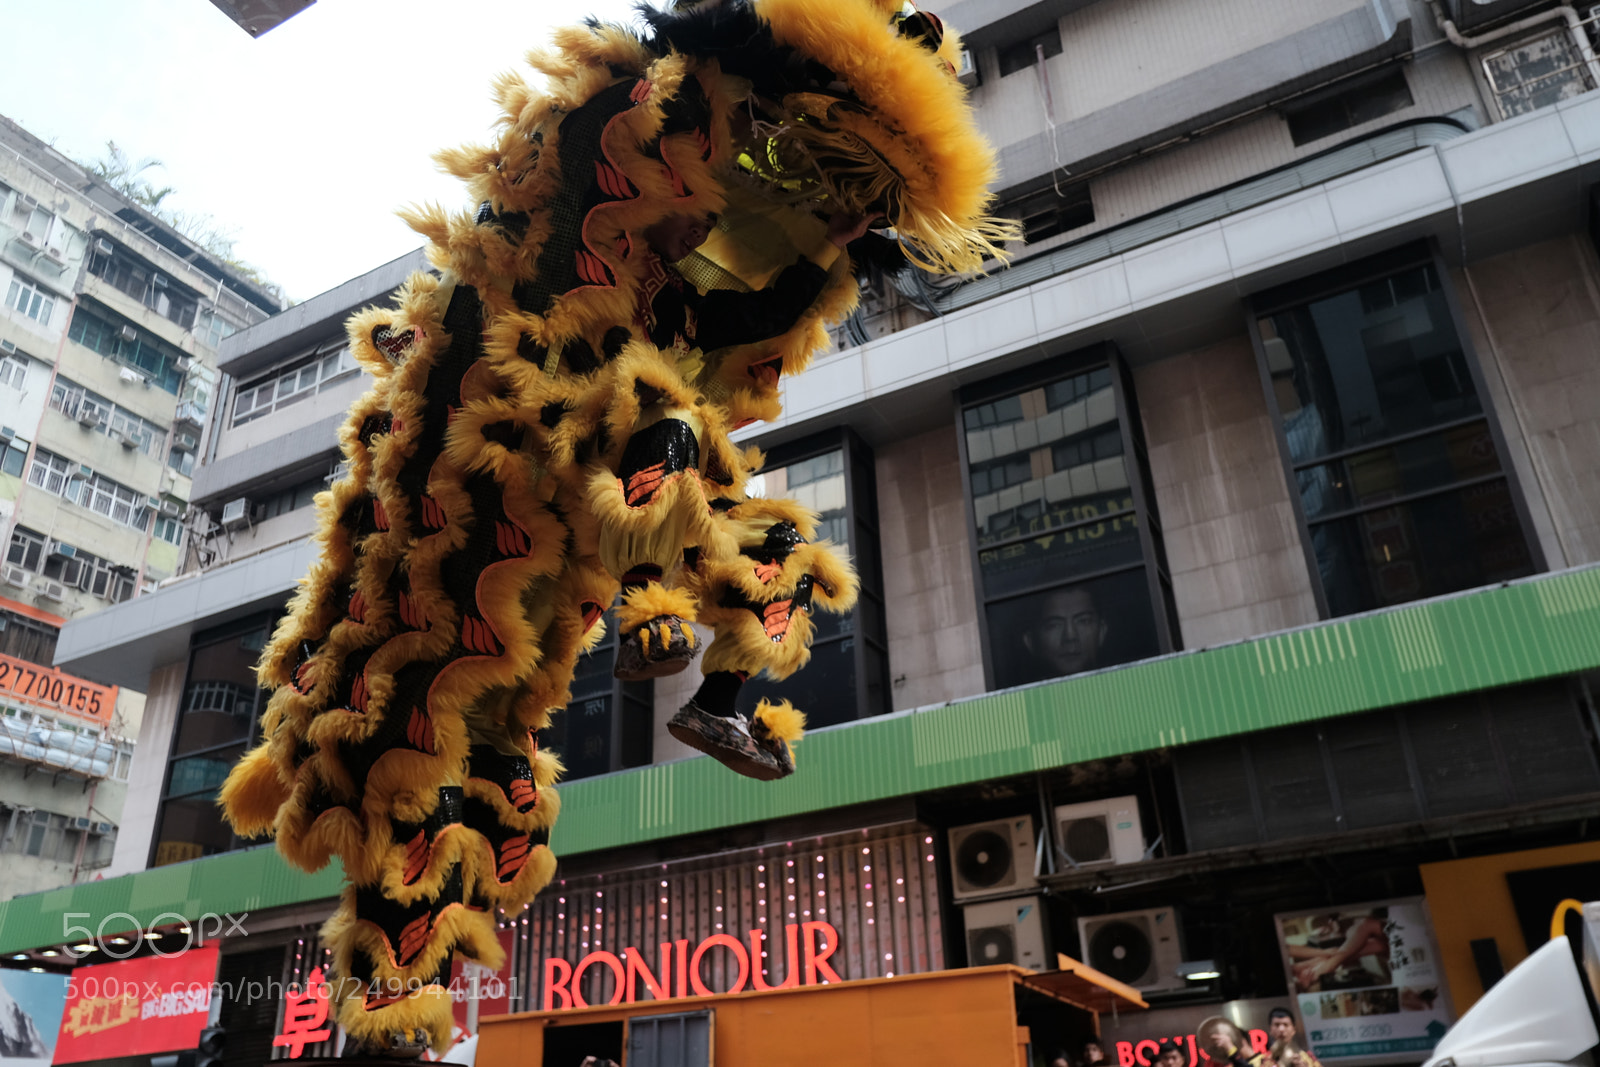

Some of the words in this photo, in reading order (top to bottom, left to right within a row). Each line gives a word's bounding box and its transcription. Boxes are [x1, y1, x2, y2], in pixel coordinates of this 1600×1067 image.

[0, 662, 103, 714] 27700155
[141, 1000, 159, 1020] BIG
[158, 992, 183, 1017] BIG
[183, 989, 211, 1013] SAL
